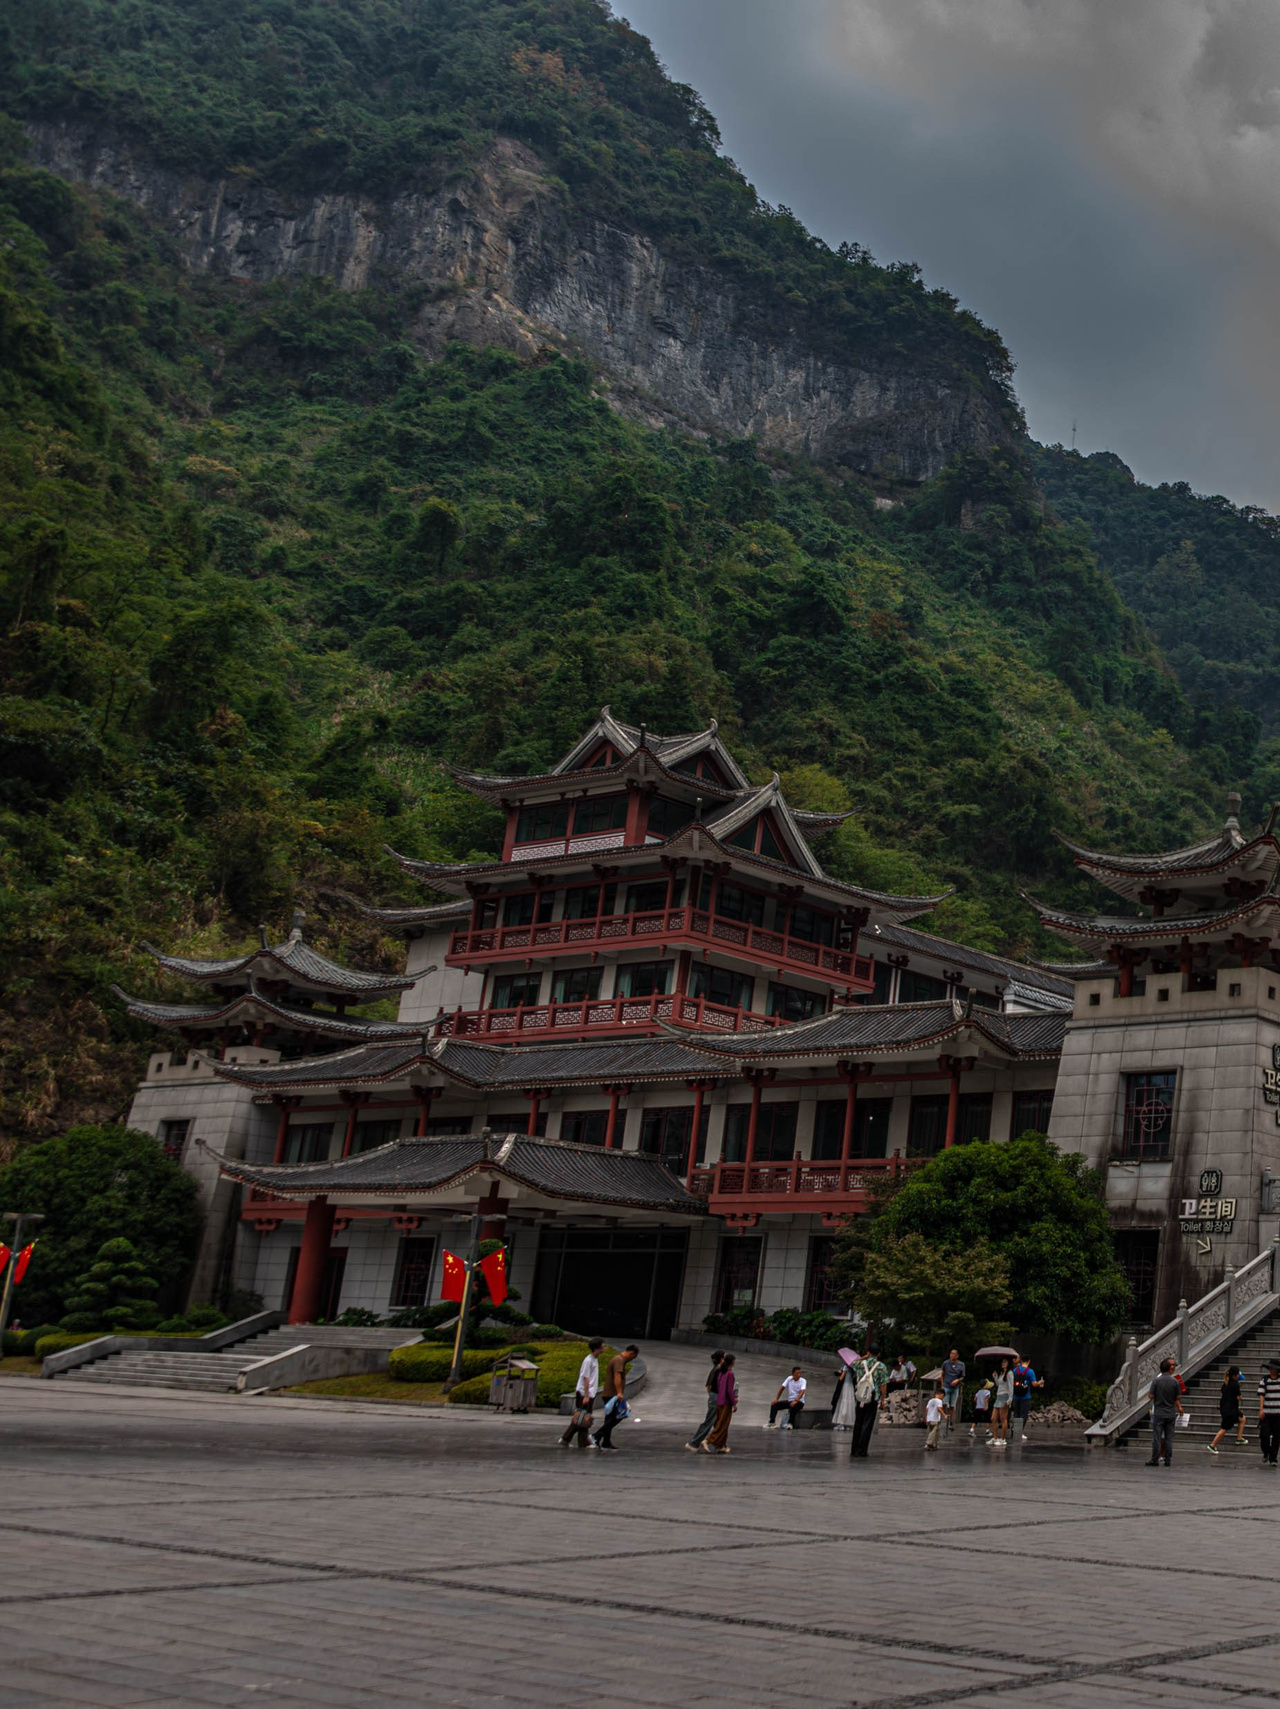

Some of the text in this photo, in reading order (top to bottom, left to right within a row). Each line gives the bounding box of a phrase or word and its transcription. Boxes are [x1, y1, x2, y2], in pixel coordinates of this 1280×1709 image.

[1265, 1091, 1279, 1104] Toilet
[1179, 1198, 1237, 1219] 卫生间
[1180, 1221, 1231, 1232] Toilet 화장실
